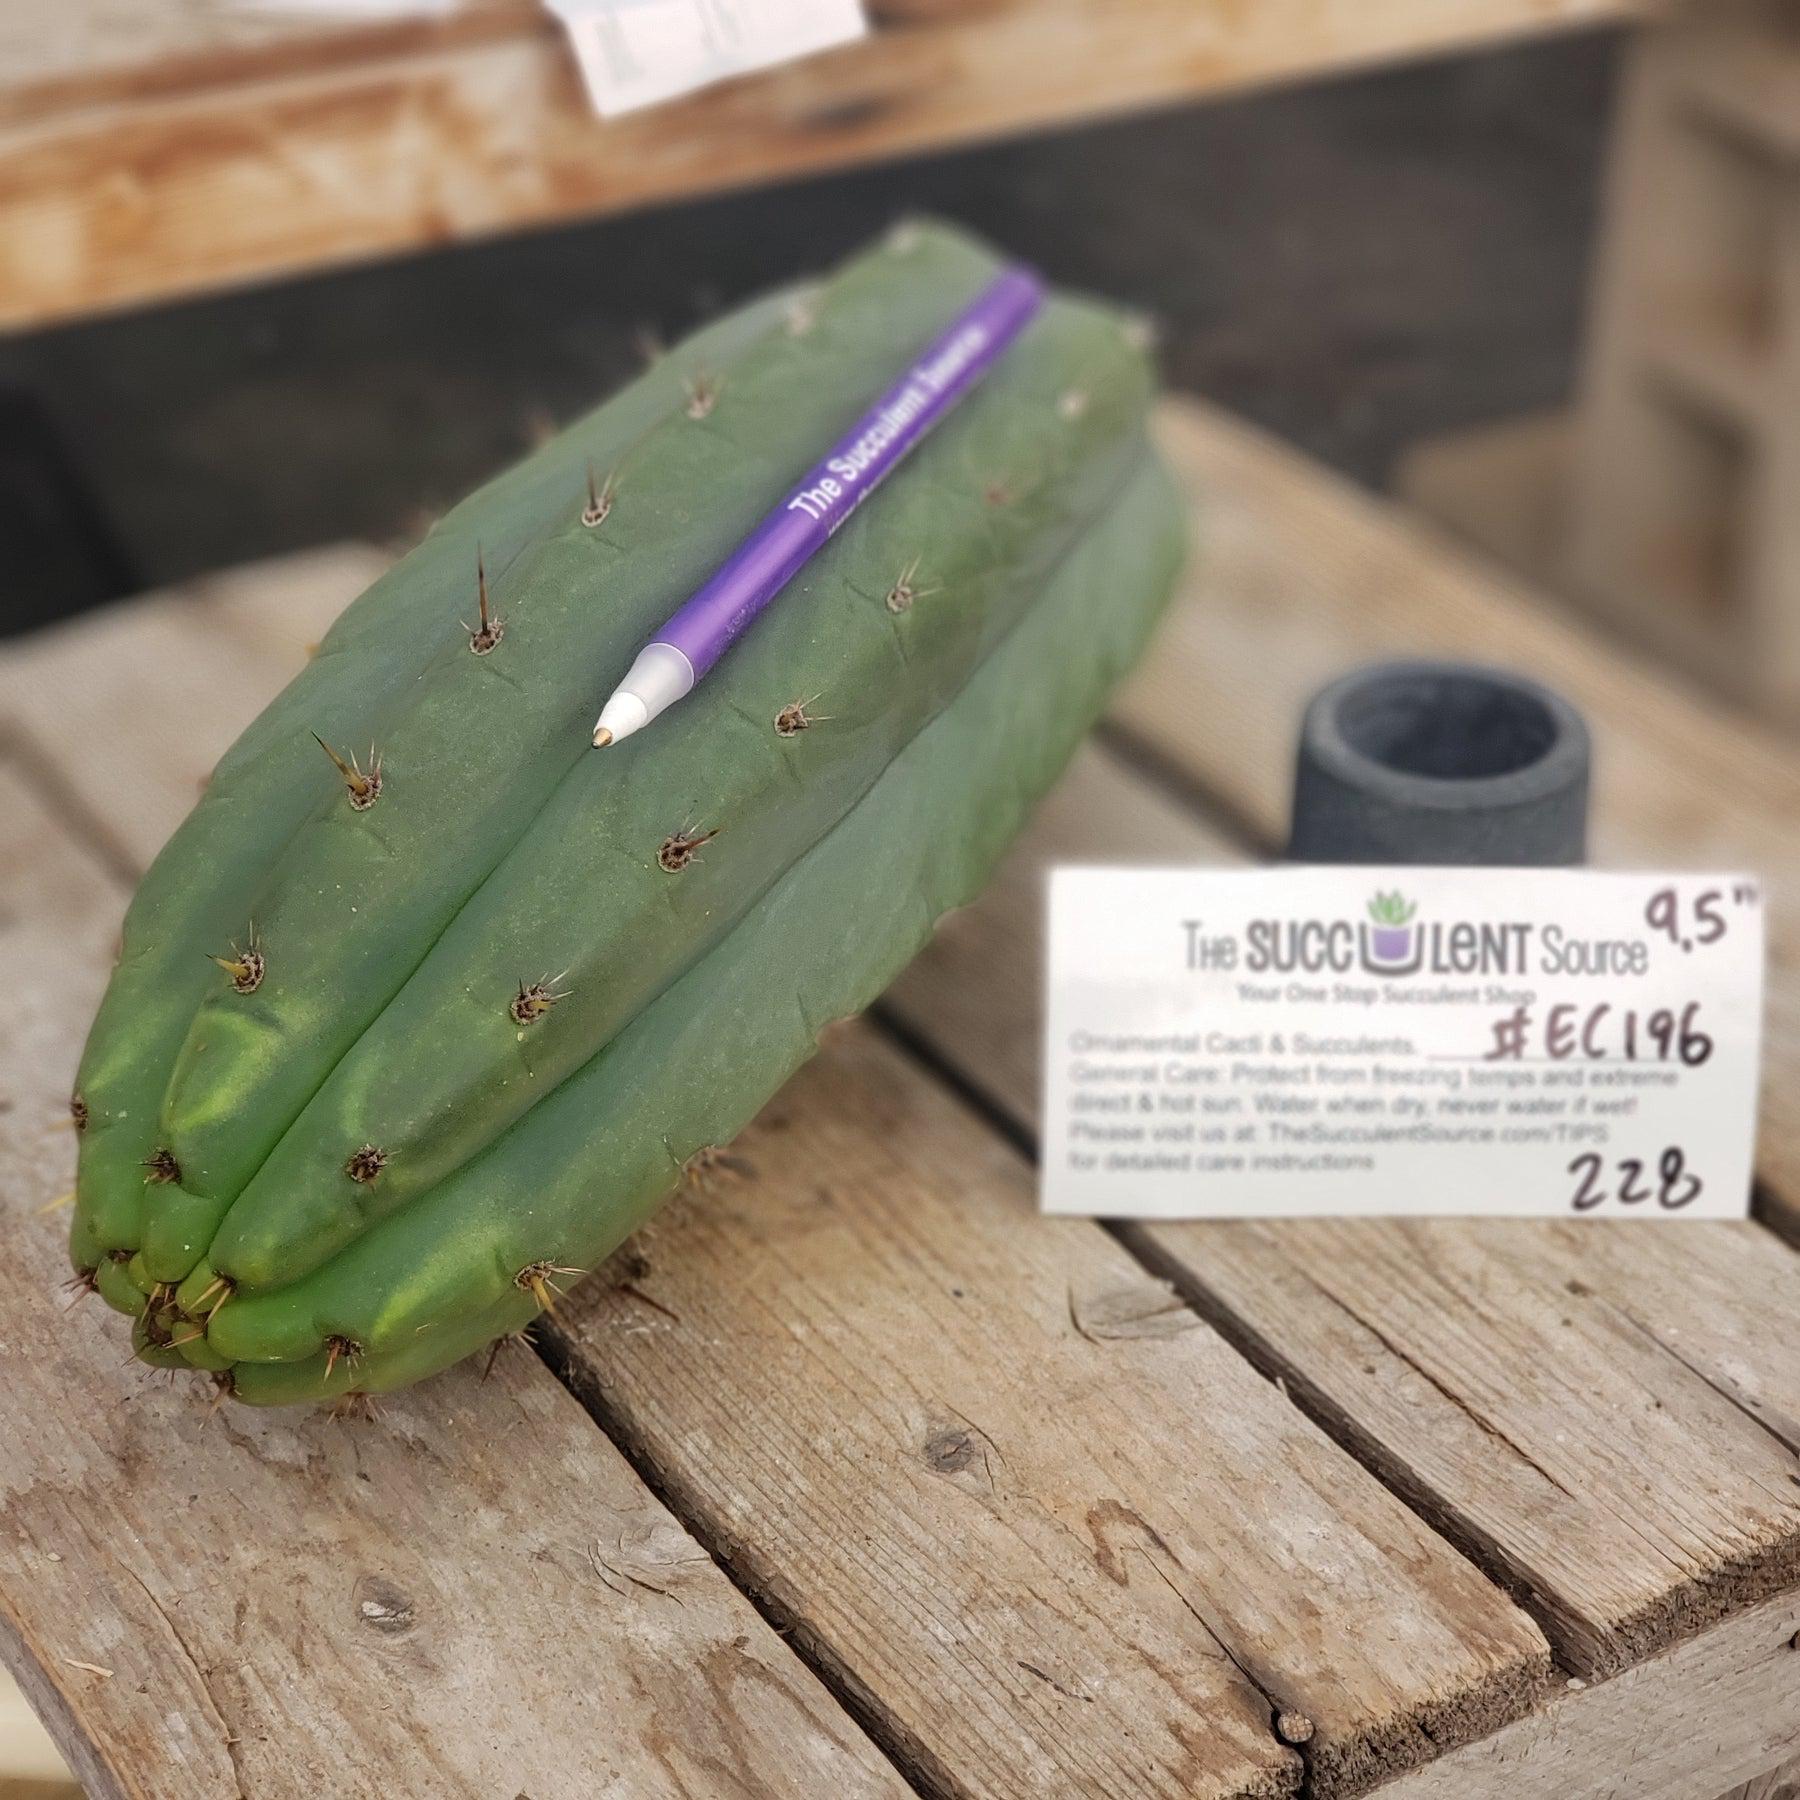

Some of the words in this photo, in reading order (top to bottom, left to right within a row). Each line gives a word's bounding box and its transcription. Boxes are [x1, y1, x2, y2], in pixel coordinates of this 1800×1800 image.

[787, 477, 842, 520] The
[1540, 924, 1650, 976] Source
[1286, 983, 1327, 1002] One
[1334, 983, 1378, 1006] Stop
[1384, 984, 1479, 1004] Succulent
[1542, 1068, 1583, 1086] and
[1138, 1093, 1153, 1113] &
[1567, 1145, 1703, 1211] 228
